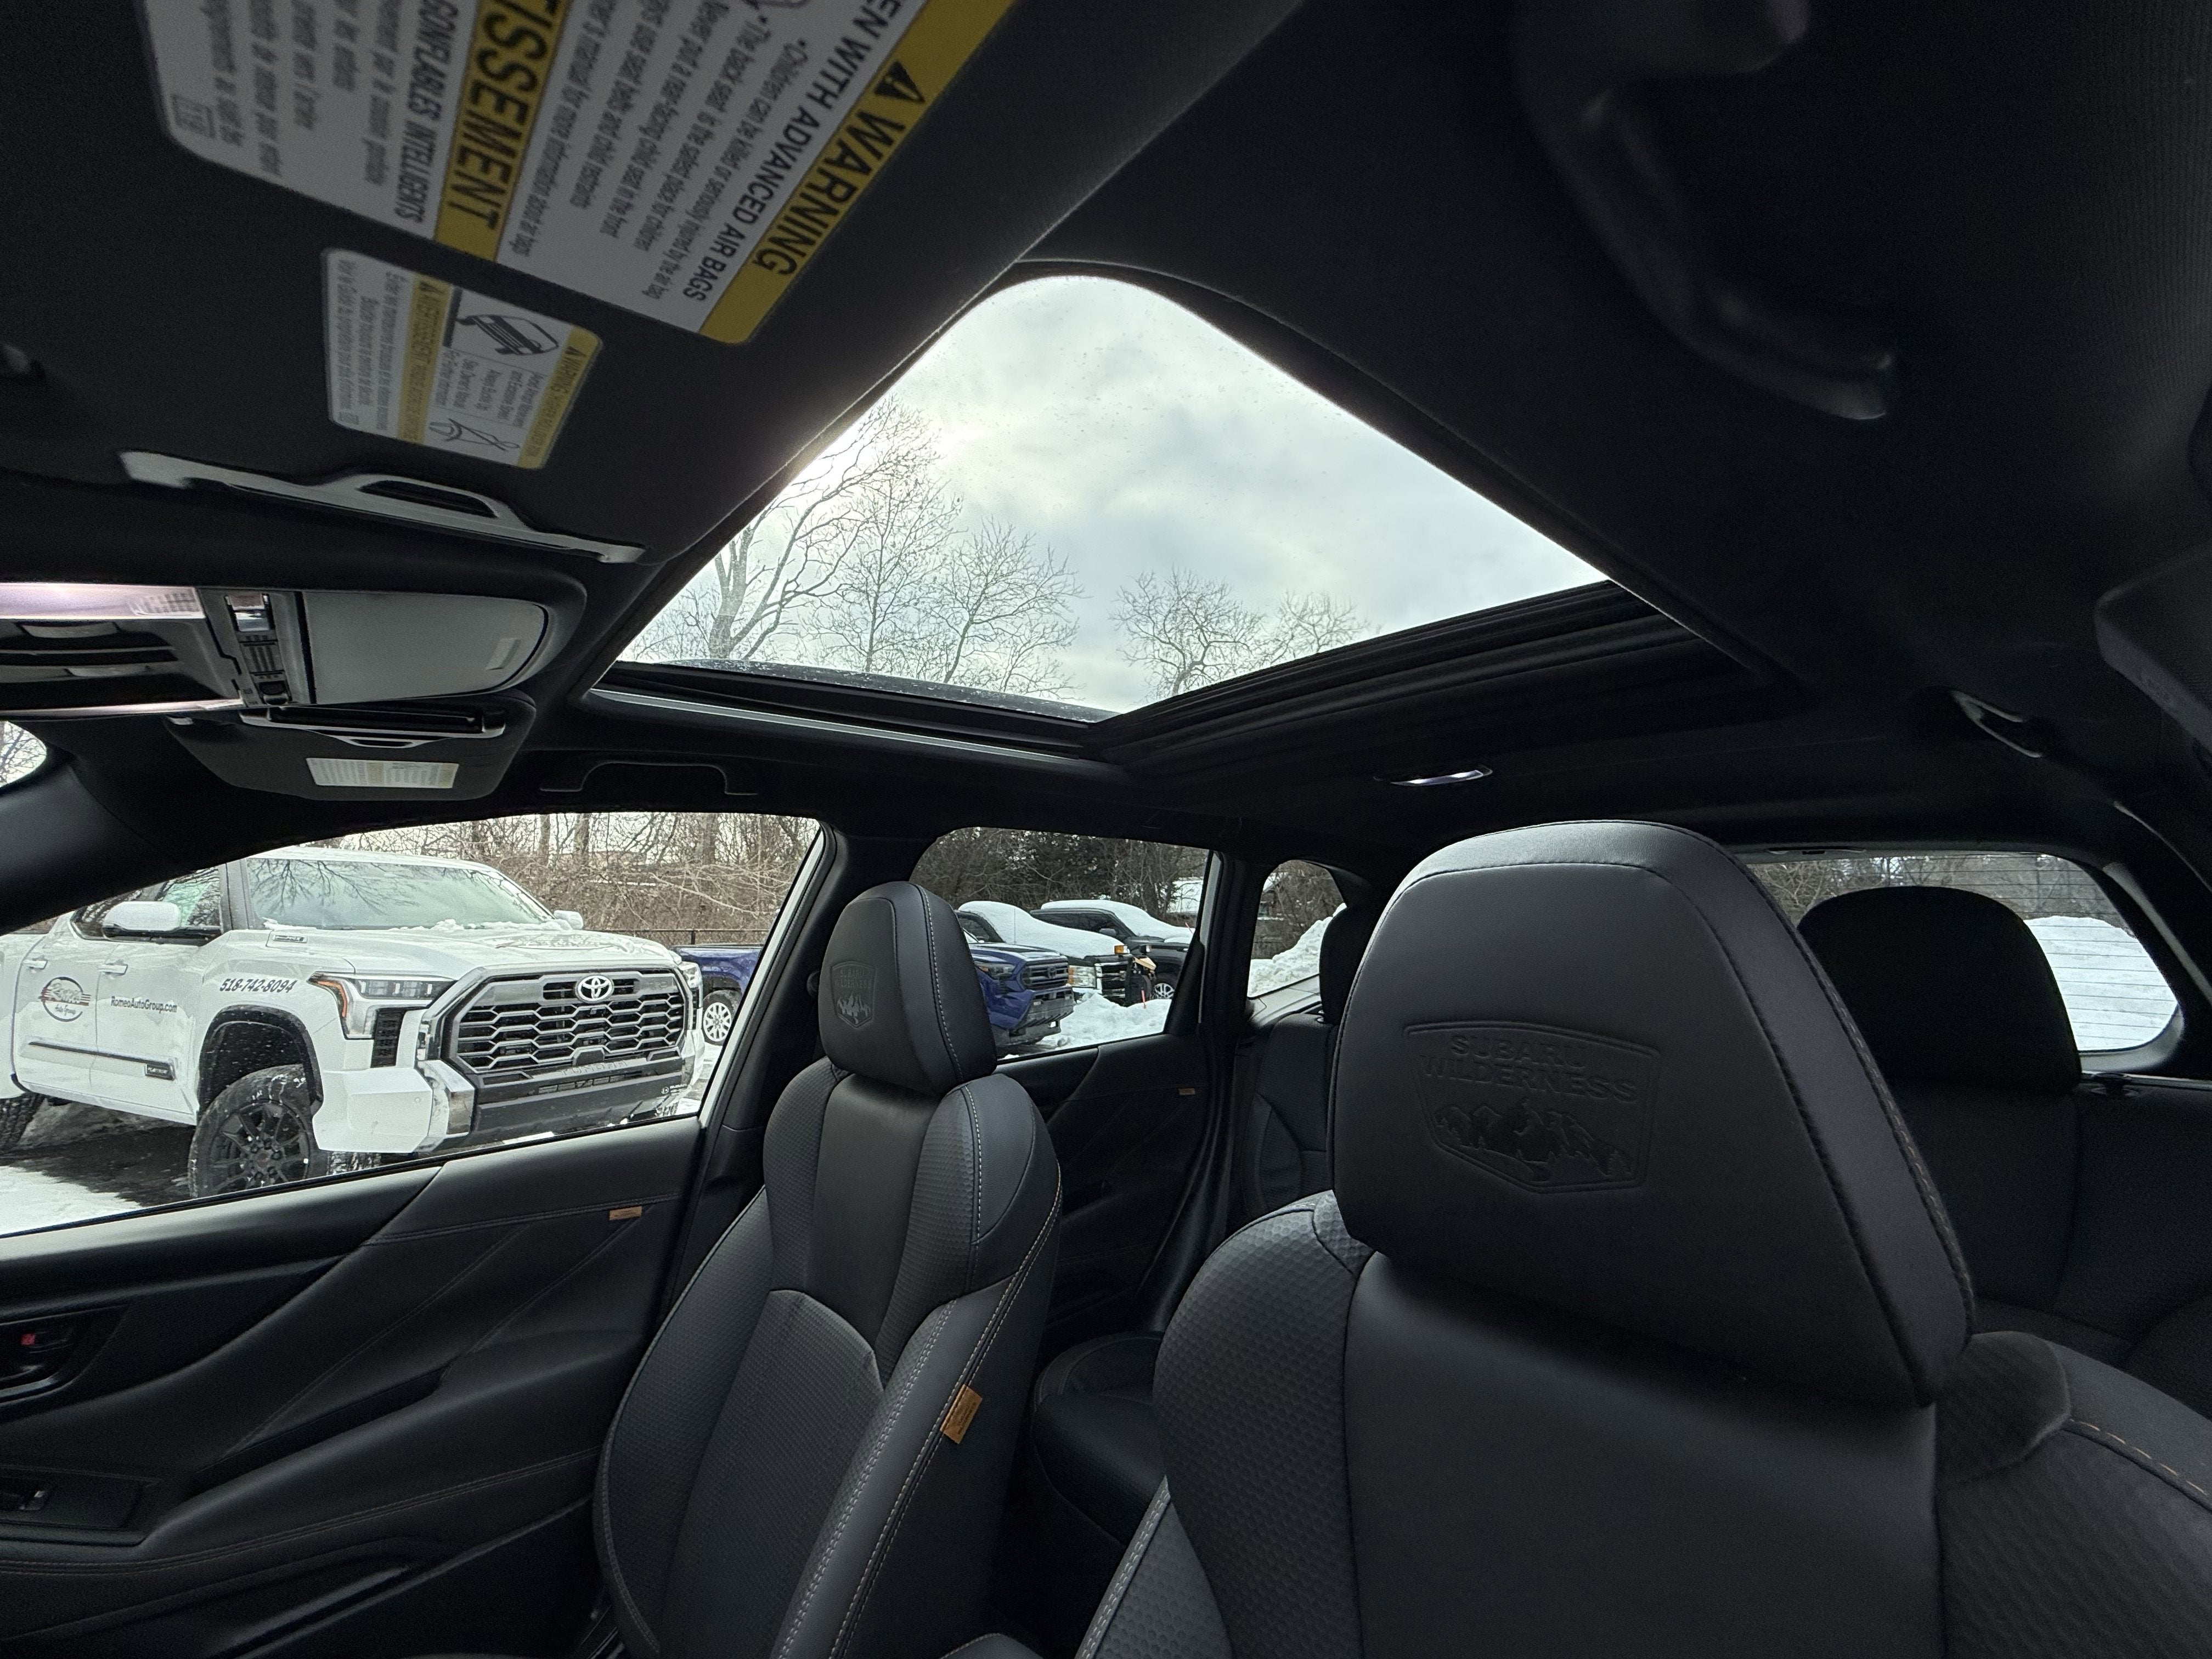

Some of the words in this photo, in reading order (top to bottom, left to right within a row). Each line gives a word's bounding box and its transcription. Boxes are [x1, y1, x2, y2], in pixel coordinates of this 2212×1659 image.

[736, 23, 772, 52] The
[676, 37, 703, 69] put
[671, 63, 692, 77] a
[720, 48, 754, 84] back
[761, 44, 808, 100] Children
[806, 38, 870, 109] WITH
[706, 81, 732, 112] seat
[697, 111, 717, 127] is
[747, 98, 771, 123] can
[687, 124, 713, 145] the
[736, 120, 762, 139] be
[720, 138, 752, 169] killed
[733, 108, 818, 224] ADVANCED
[714, 165, 732, 182] or
[617, 187, 638, 199] in
[754, 112, 902, 274] WARNING
[609, 198, 633, 215] the
[710, 223, 745, 257] AIR
[659, 259, 680, 275] the
[663, 249, 687, 262] by
[653, 272, 670, 286] air
[683, 256, 726, 301] BAGS
[219, 978, 298, 993] 518-742-8094
[111, 996, 177, 1014] RomeoAutoGroup.com
[1450, 1033, 1587, 1069] SUBARU
[561, 1059, 628, 1076] TUNDRA
[1419, 1054, 1638, 1103] WILDERNESS
